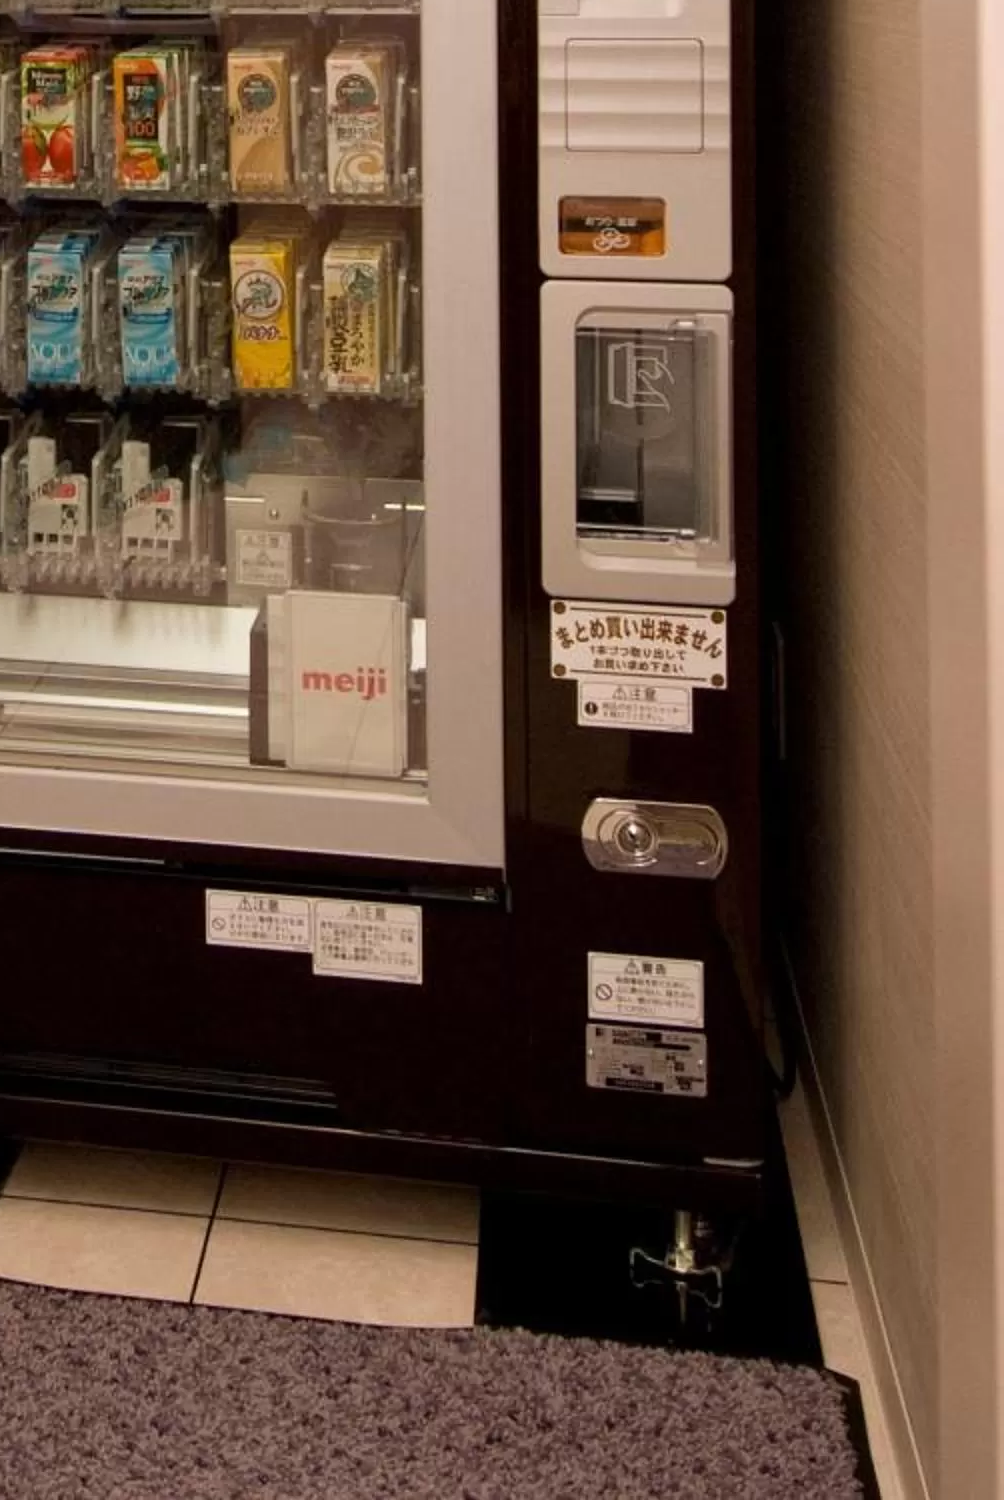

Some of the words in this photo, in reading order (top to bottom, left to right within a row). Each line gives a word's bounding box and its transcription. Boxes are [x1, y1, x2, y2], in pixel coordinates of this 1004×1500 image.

[128, 121, 156, 138] 100
[556, 615, 722, 658] まとめ買い出来ません
[593, 658, 685, 674] お買い求め下さい
[302, 666, 388, 701] meiji
